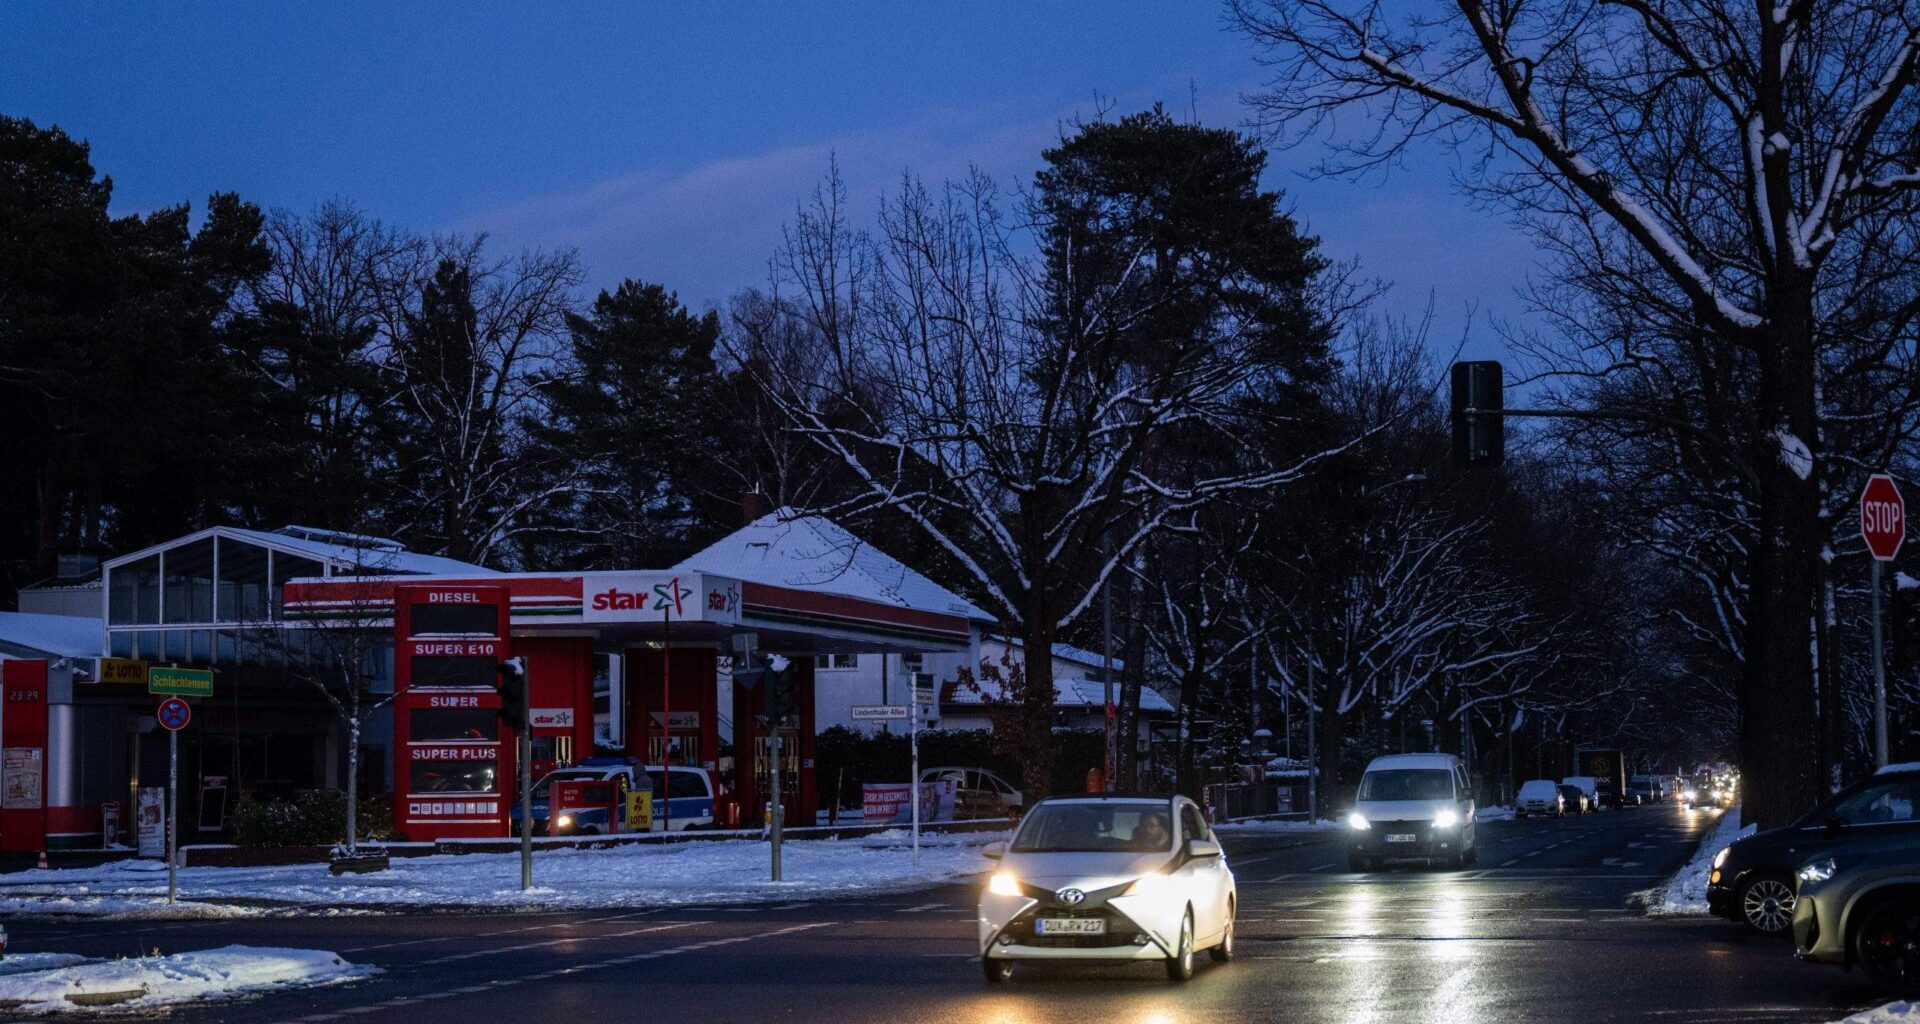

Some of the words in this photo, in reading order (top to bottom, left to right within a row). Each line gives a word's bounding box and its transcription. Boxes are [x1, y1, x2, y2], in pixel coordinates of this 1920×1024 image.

[1865, 501, 1900, 534] STOP
[429, 592, 481, 603] DIESEL
[592, 588, 649, 611] star
[708, 588, 727, 611] star
[415, 644, 464, 655] SUPER
[468, 644, 494, 655] E10
[117, 664, 143, 678] LOTTO
[153, 674, 210, 690] Schlachtensee
[430, 696, 479, 707] SUPER
[855, 707, 889, 716] Lindenthaler
[890, 708, 905, 716] Allee
[534, 715, 555, 724] star
[412, 749, 458, 760] SUPER
[462, 748, 497, 760] PLUS
[630, 815, 648, 825] LOTTO
[1084, 920, 1103, 932] 217
